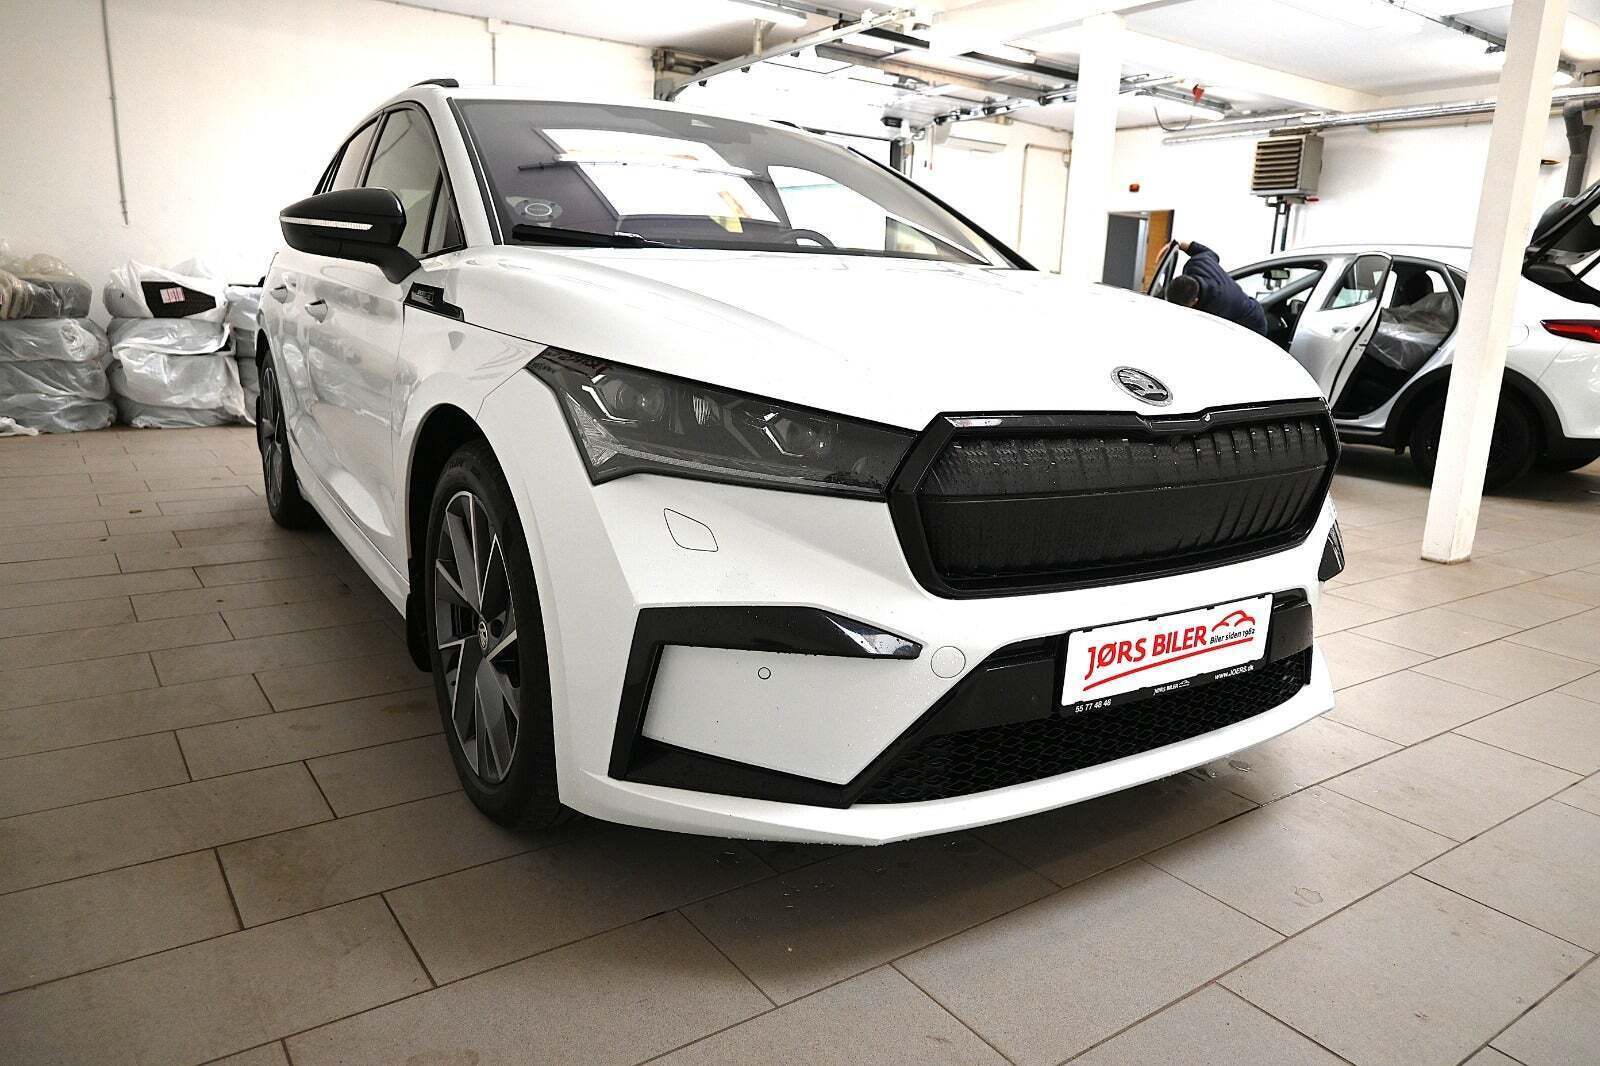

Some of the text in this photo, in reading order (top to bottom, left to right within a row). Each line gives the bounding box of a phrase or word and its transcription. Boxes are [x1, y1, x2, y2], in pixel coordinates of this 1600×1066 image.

[1209, 627, 1256, 645] Biler siden 1962
[1084, 625, 1208, 680] JØRS BILER
[1074, 698, 1112, 713] 55 77 48 48
